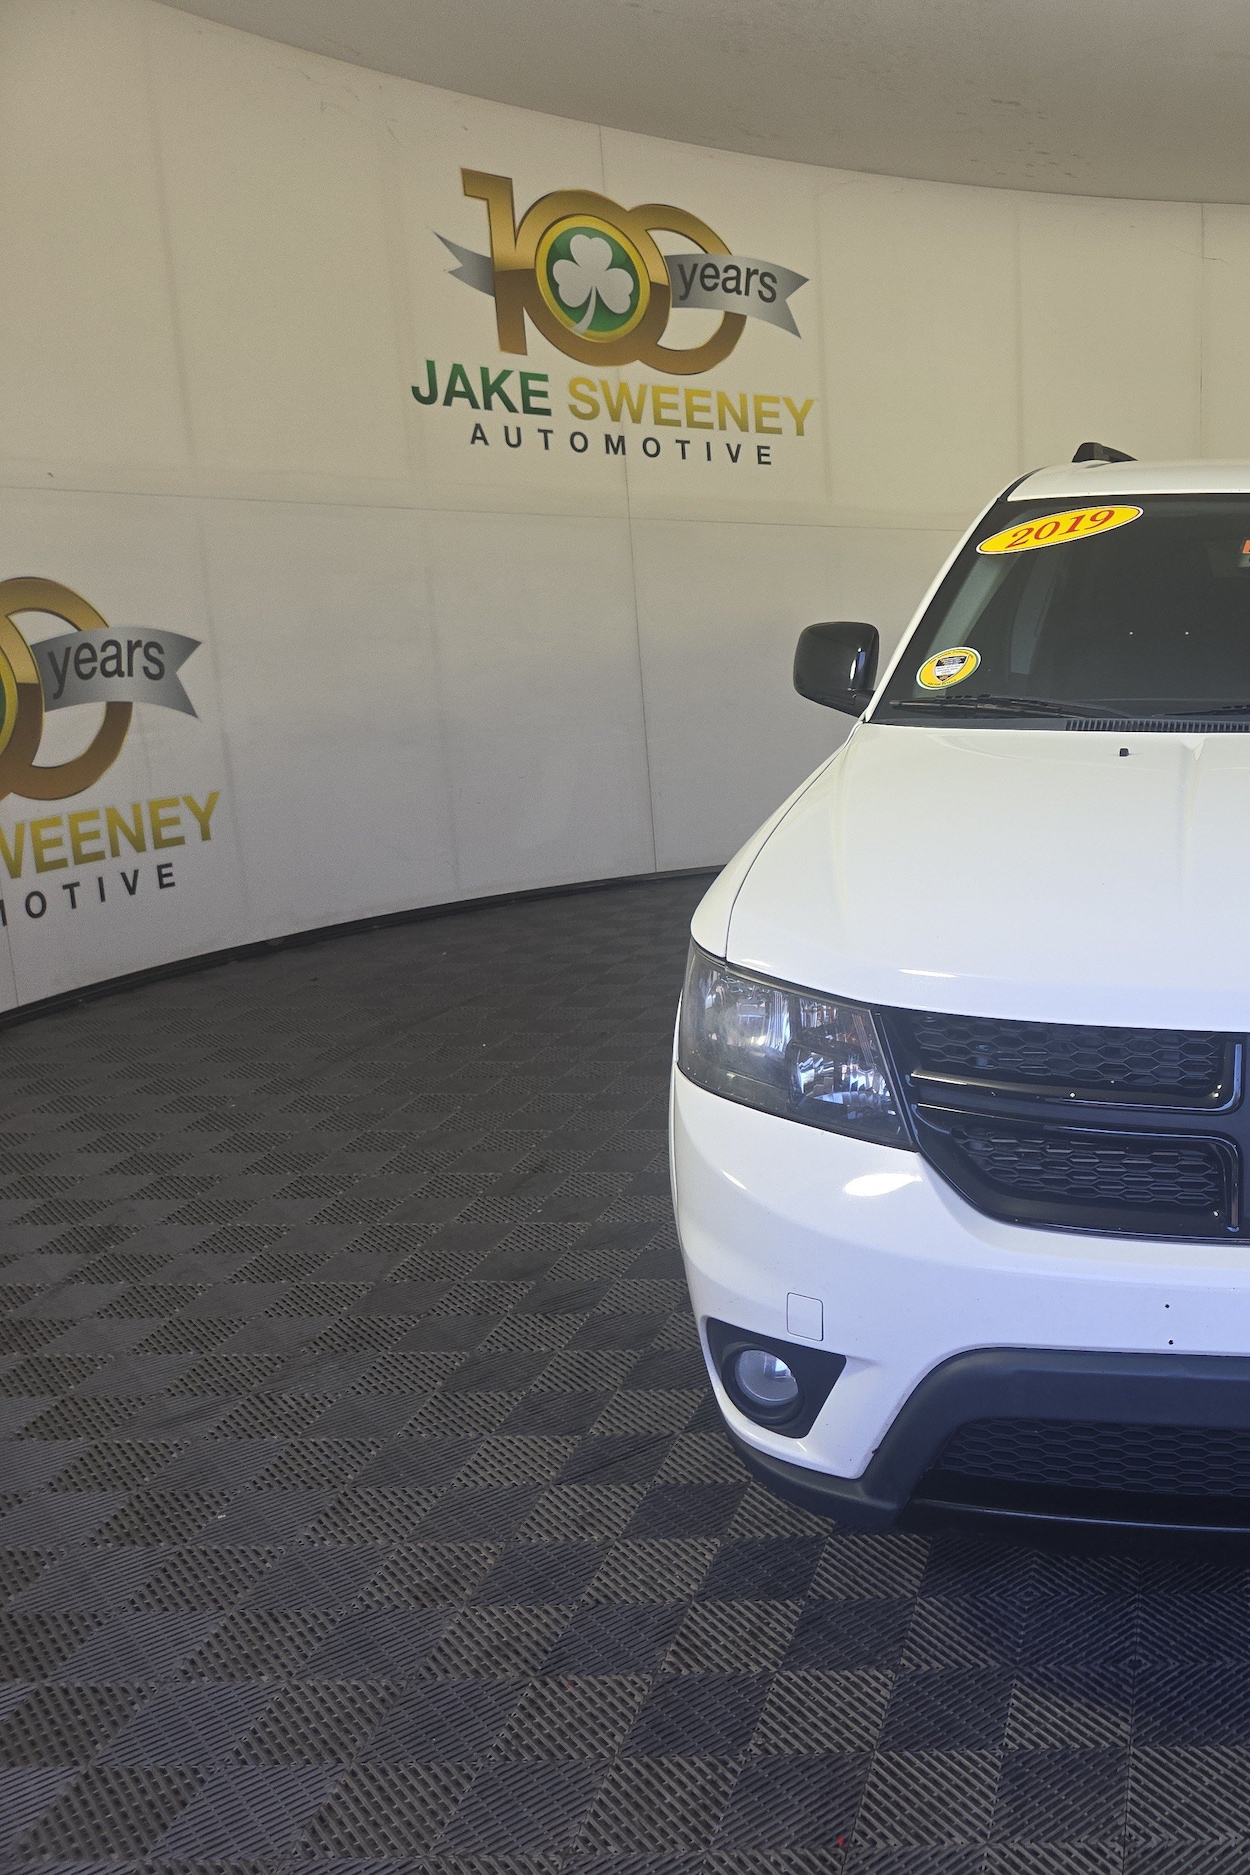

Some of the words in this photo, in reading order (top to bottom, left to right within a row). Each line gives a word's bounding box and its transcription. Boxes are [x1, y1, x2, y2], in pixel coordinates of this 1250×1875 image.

[461, 168, 747, 376] 100
[678, 262, 778, 303] years
[411, 360, 552, 417] JAKE
[568, 377, 814, 437] SWEENEY
[470, 423, 772, 465] AUTOMOTIVE
[1005, 509, 1115, 549] 2019
[47, 638, 165, 699] years
[0, 863, 176, 927] OTIVE
